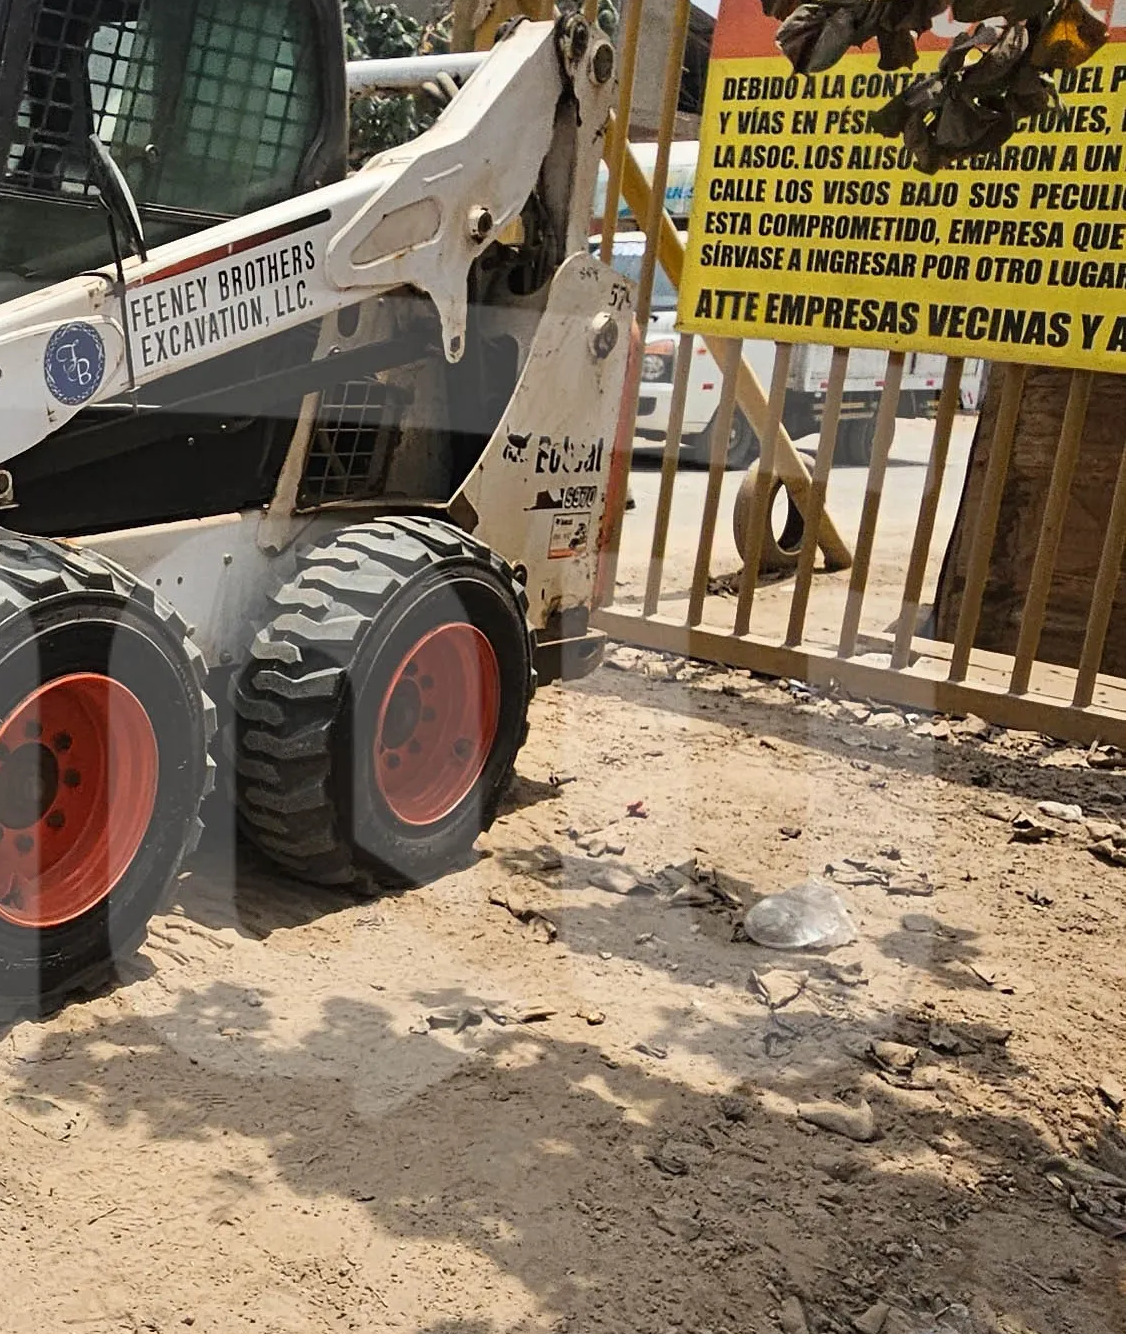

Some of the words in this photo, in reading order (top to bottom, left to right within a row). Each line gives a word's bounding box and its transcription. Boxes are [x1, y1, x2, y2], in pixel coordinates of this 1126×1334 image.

[722, 74, 800, 101] DEBIDO
[802, 75, 816, 99] A
[821, 74, 845, 99] LA
[1058, 66, 1104, 94] DEL
[719, 111, 732, 135] Y
[738, 106, 785, 135] VÍAS
[791, 110, 818, 135] EN
[713, 145, 735, 168] LA
[738, 145, 798, 169] ASOC.
[803, 145, 844, 169] LOS
[1058, 146, 1078, 172] A
[1083, 146, 1123, 173] UN
[709, 178, 767, 202] CALLE
[774, 180, 813, 204] LOS
[823, 180, 891, 206] VISOS
[900, 181, 959, 208] BAJO
[968, 183, 1020, 209] SUS
[1029, 184, 1126, 212] PECULI
[704, 211, 752, 236] ESTA
[758, 213, 940, 246] COMPROMETIDO,
[948, 219, 1064, 249] EMPRESA
[1072, 222, 1126, 253] QUE
[700, 241, 785, 270] SÍRVASE
[786, 248, 802, 272] A
[806, 249, 918, 278] INGRESAR
[921, 254, 971, 281] POR
[975, 256, 1042, 285] OTRO
[130, 275, 209, 332] FEENEY
[218, 240, 317, 300] BROTHERS
[141, 297, 271, 368] EXCAVATION,
[272, 281, 314, 317] LLC.
[693, 288, 760, 322] ATTE
[764, 293, 920, 336] EMPRESAS
[928, 303, 1071, 349] VECINAS
[1081, 312, 1106, 352] Y
